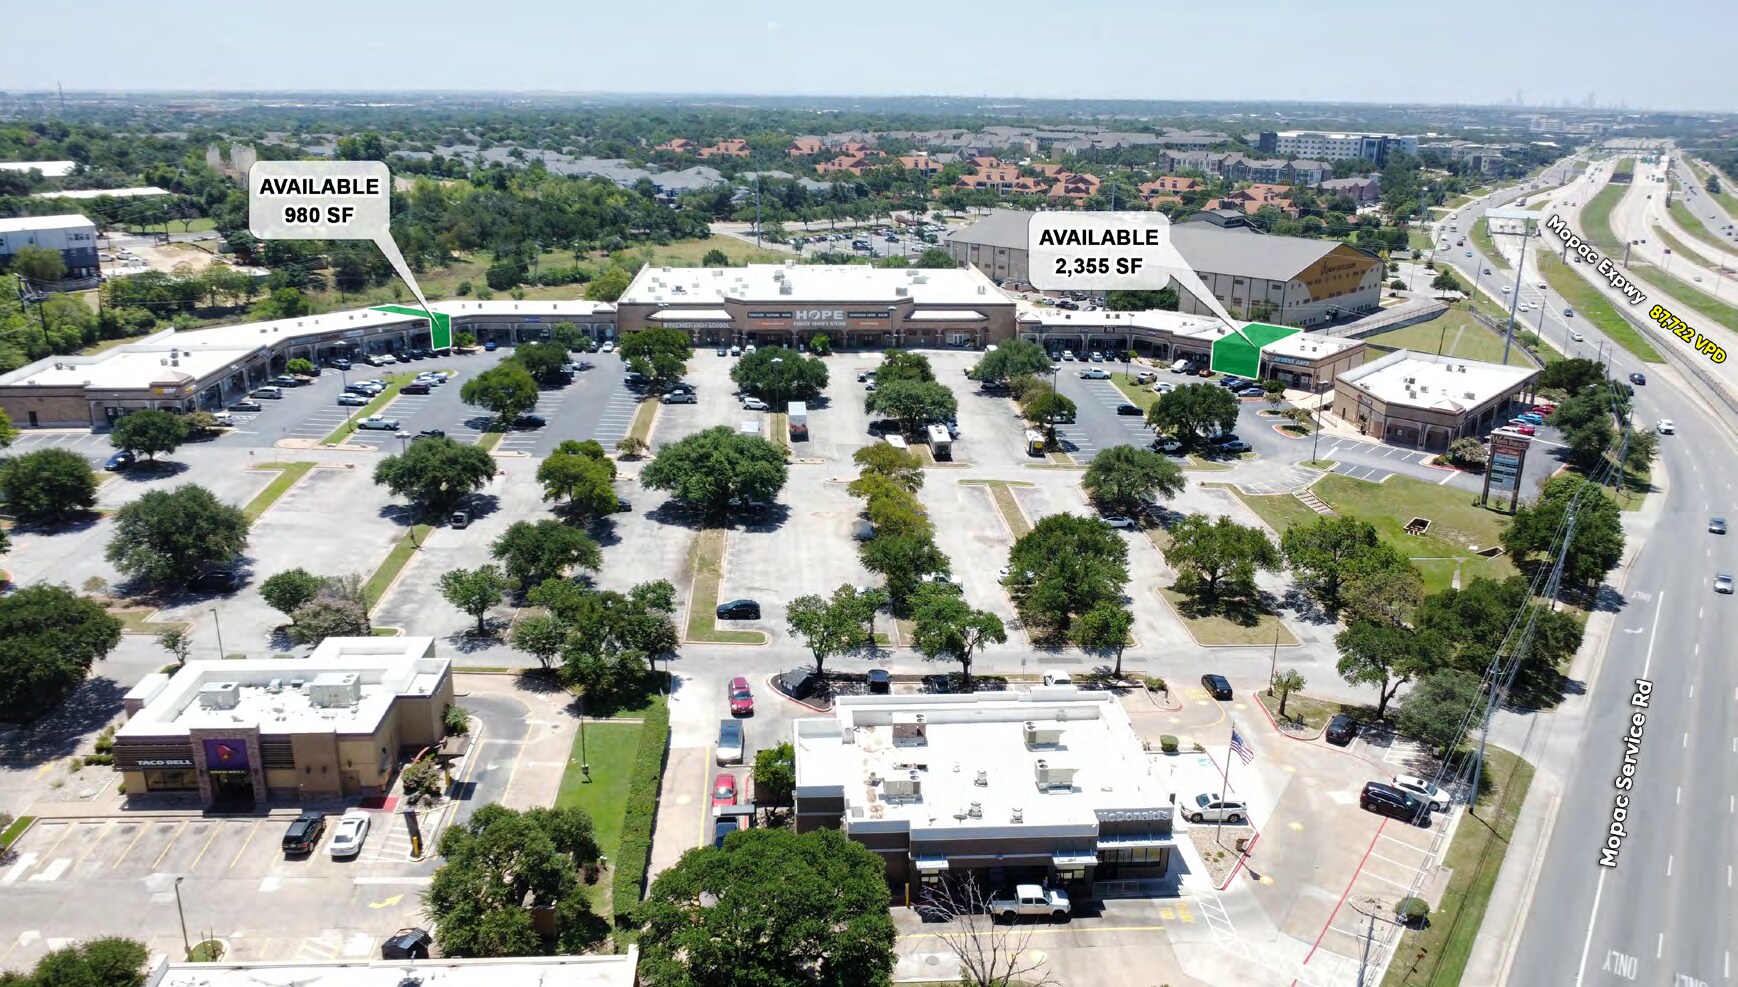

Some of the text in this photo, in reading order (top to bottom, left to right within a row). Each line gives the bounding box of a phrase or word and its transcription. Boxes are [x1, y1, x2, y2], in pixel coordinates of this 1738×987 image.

[796, 310, 843, 320] HOPE
[1097, 809, 1170, 822] McDonald's
[1602, 949, 1638, 980] ONLY
